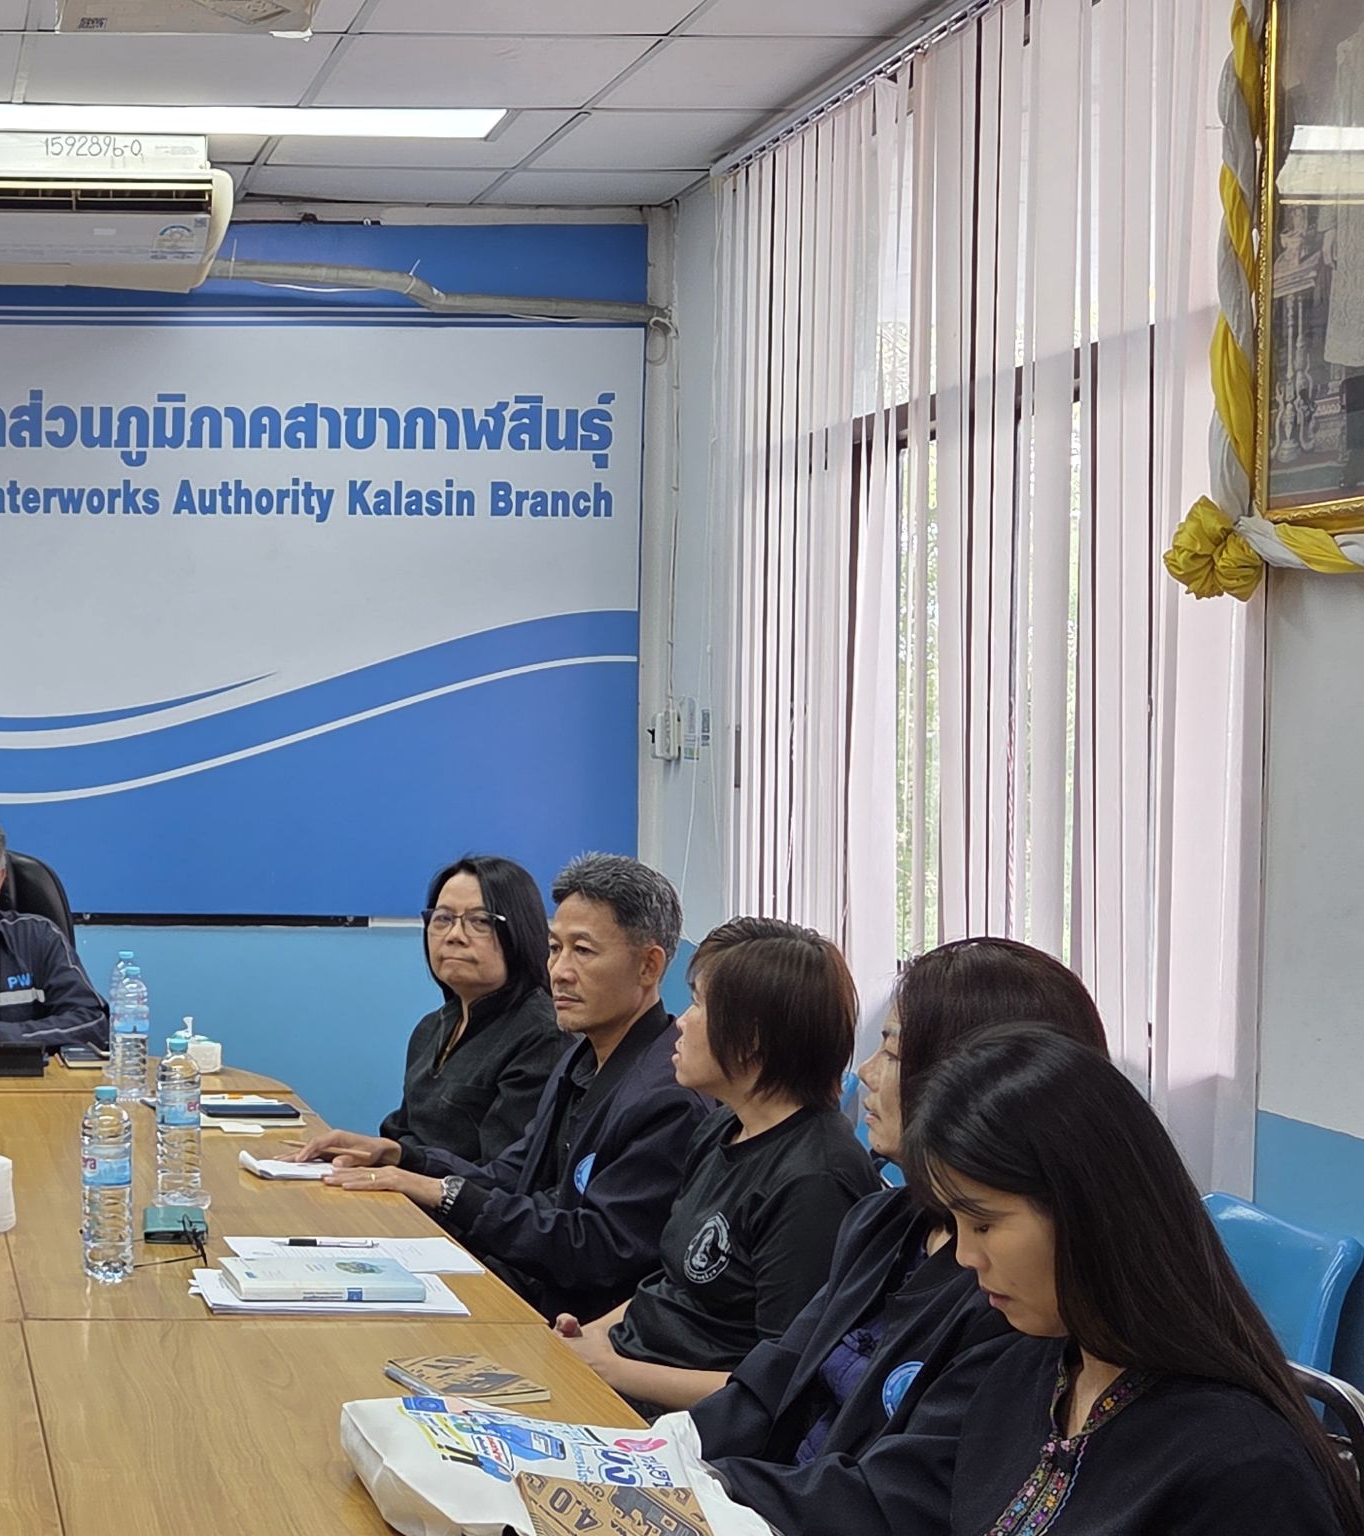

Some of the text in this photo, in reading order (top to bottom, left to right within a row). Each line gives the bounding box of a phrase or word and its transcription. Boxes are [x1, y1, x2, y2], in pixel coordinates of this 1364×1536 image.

[173, 478, 334, 523] Authority
[347, 479, 476, 517] Kalasin
[489, 480, 613, 518] Branch
[7, 972, 32, 990] PW
